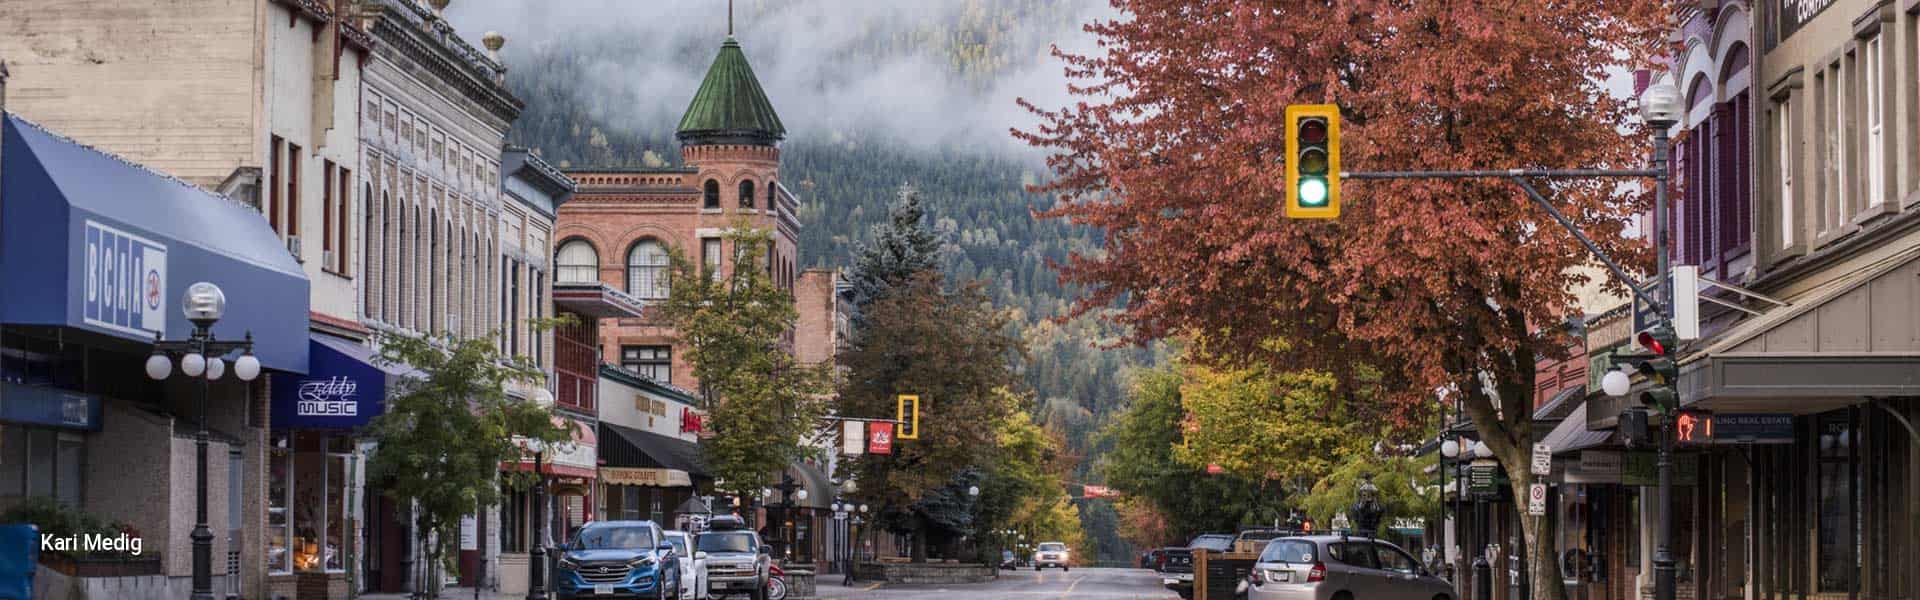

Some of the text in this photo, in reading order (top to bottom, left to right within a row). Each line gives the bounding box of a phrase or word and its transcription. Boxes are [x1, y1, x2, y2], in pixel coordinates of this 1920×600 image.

[1797, 0, 1832, 23] COMP
[88, 242, 141, 314] BCAA
[298, 376, 357, 401] Eddy
[299, 401, 356, 415] MUSIC
[1738, 416, 1760, 425] REAL
[1761, 416, 1792, 425] ESTATE
